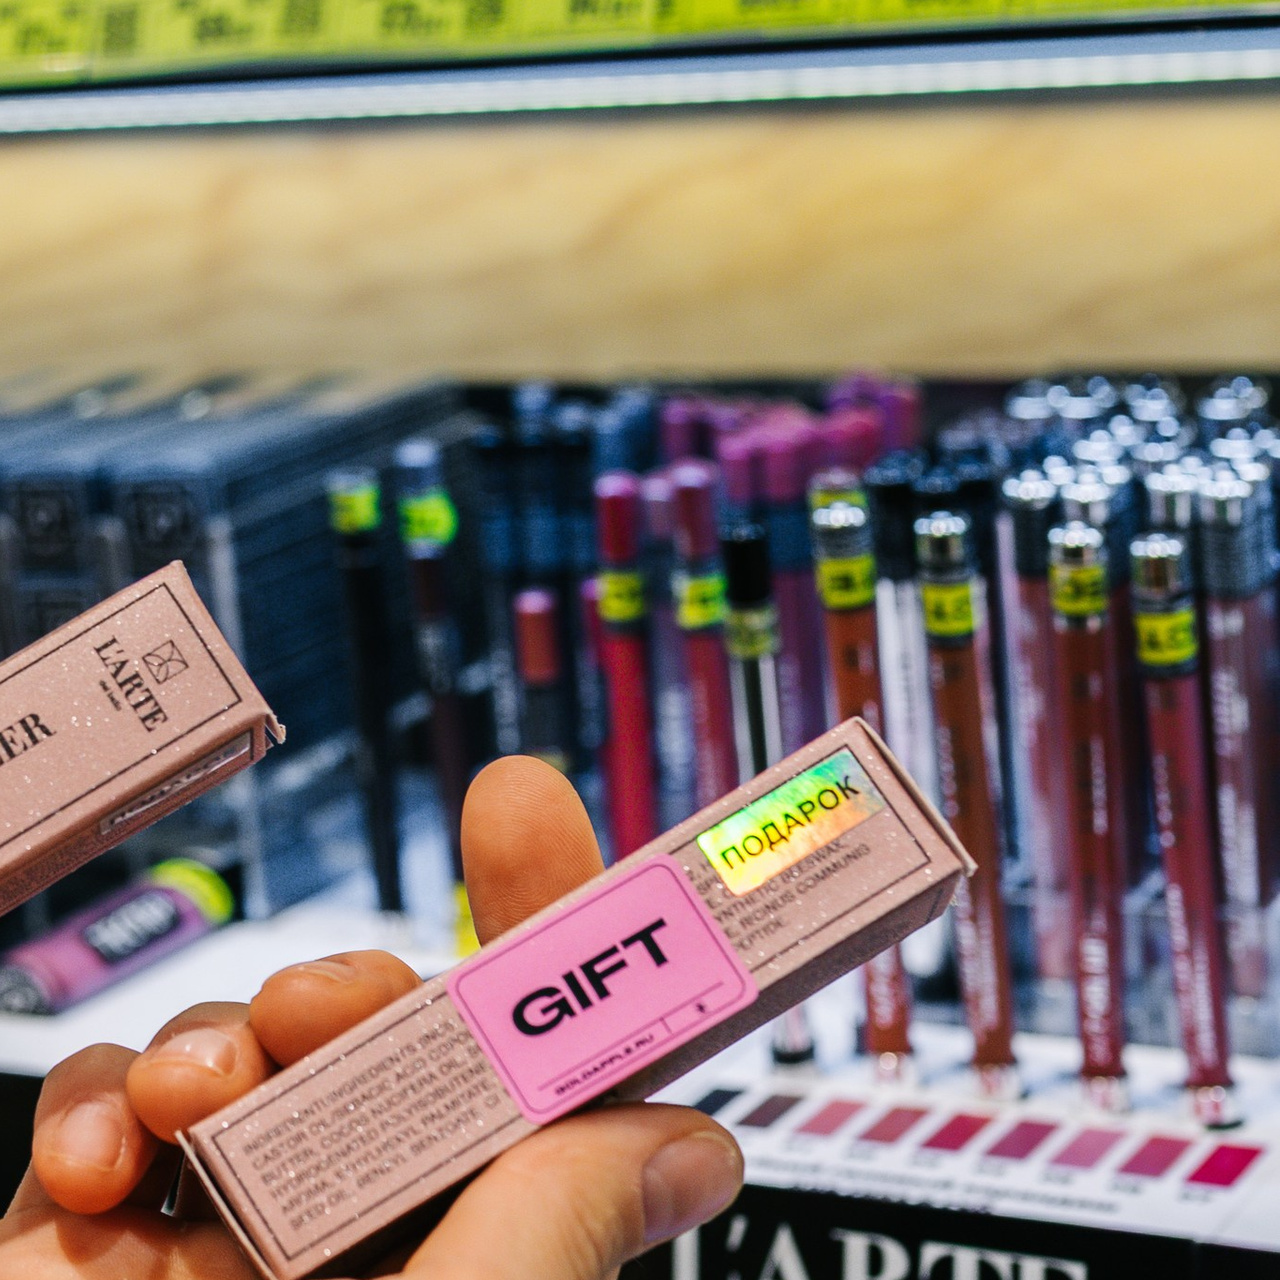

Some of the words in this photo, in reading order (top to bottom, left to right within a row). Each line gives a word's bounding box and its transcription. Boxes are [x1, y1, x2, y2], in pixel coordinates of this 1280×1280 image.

[93, 632, 169, 735] L'ARTE
[720, 774, 862, 870] ПОДАРОК
[513, 919, 669, 1036] GIFT
